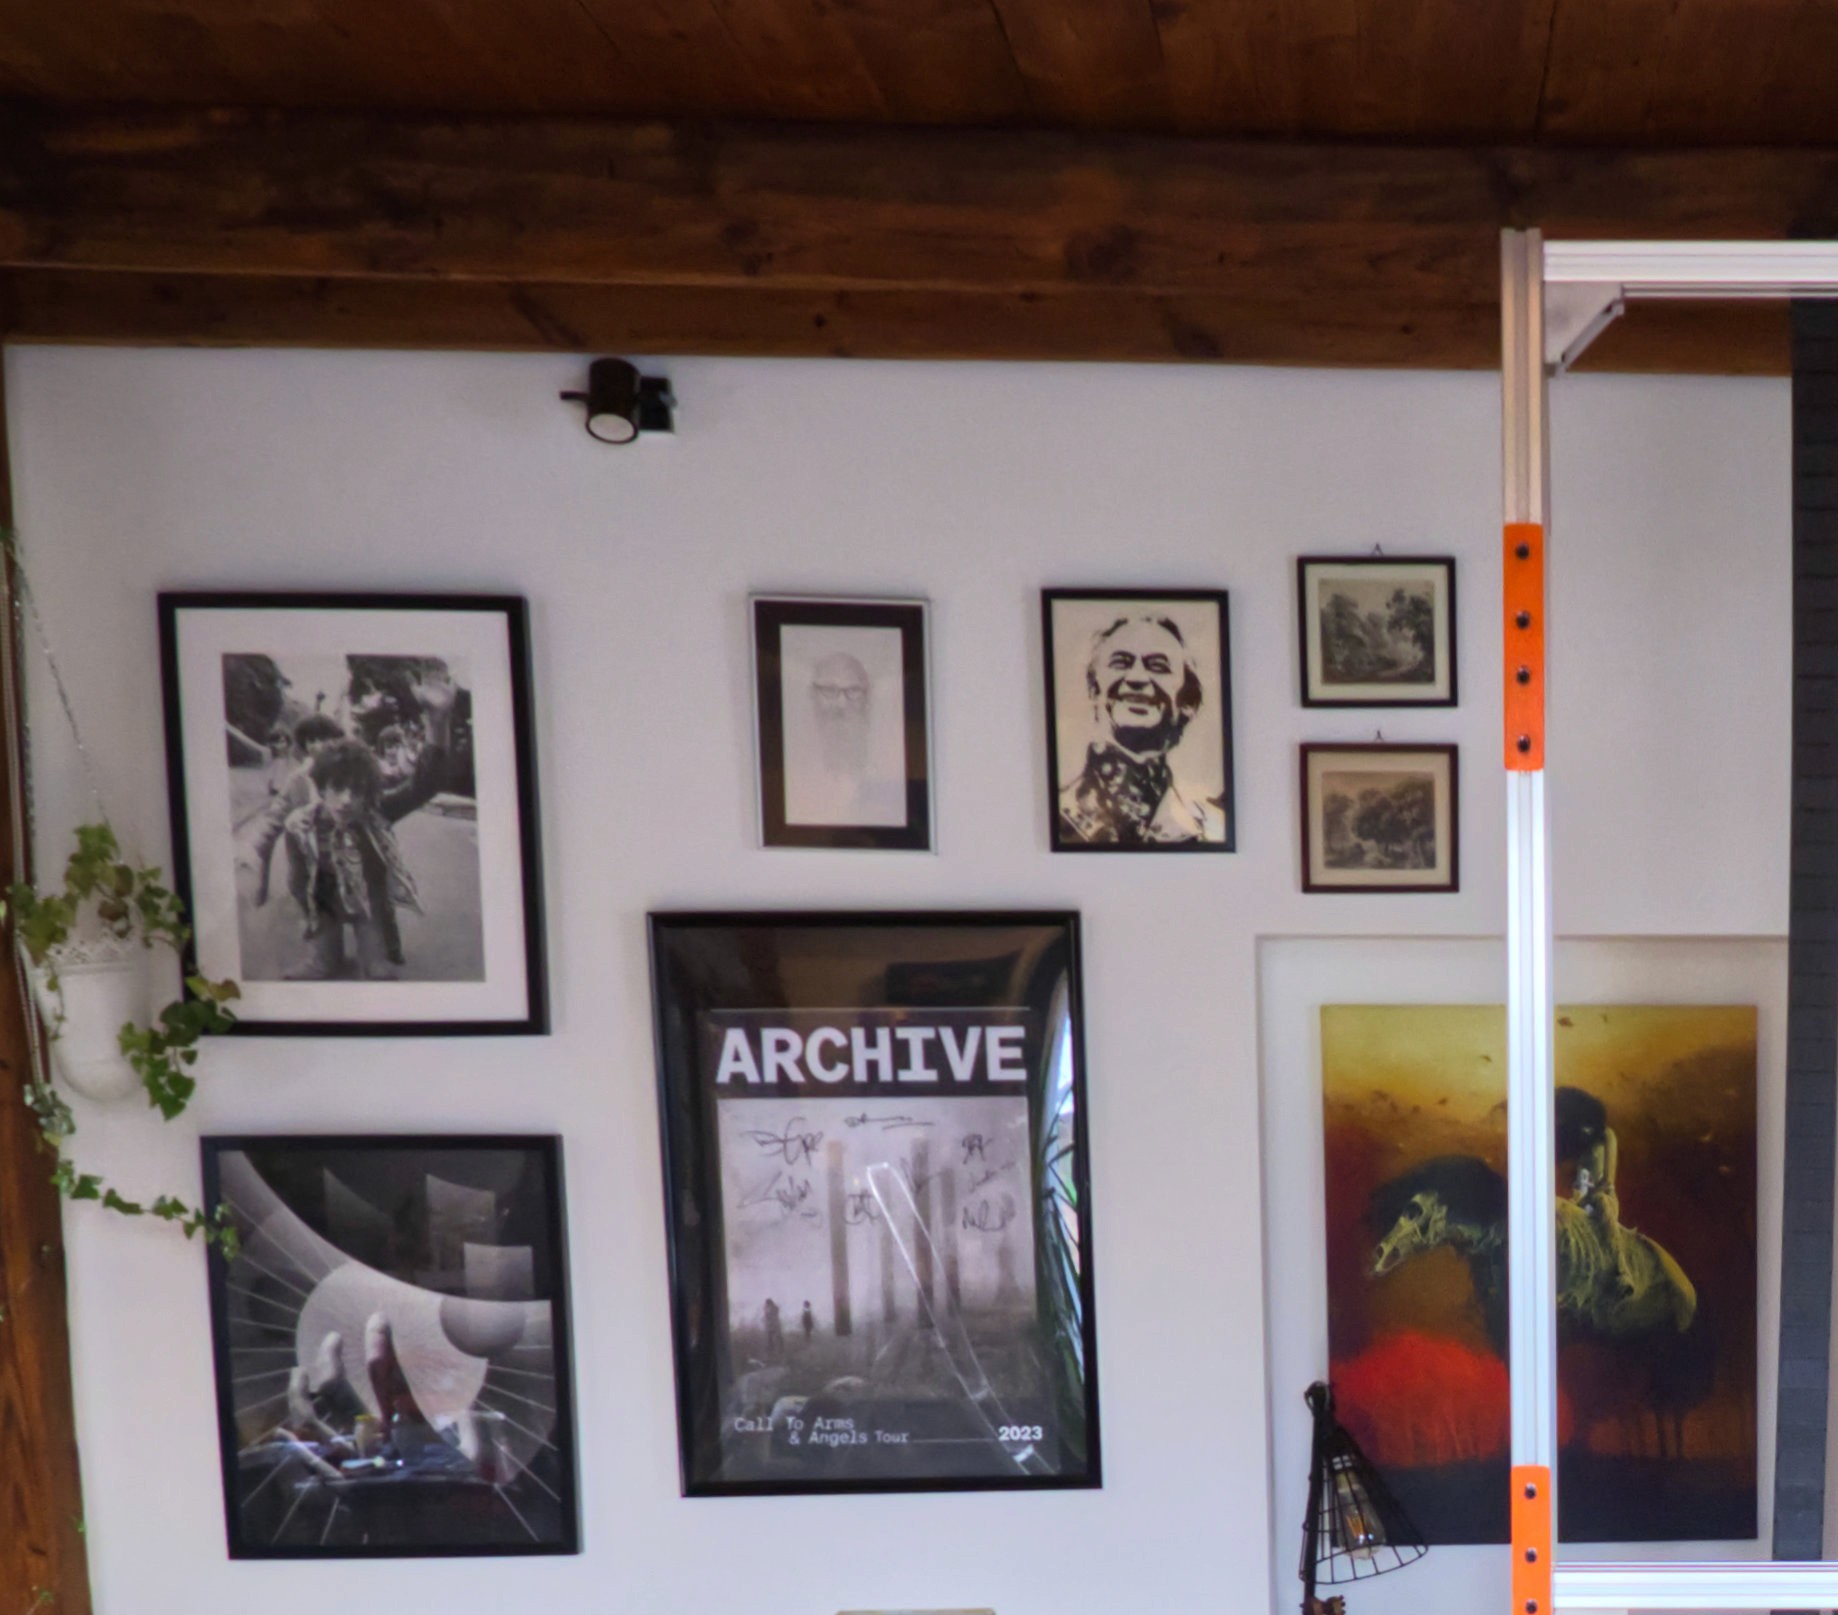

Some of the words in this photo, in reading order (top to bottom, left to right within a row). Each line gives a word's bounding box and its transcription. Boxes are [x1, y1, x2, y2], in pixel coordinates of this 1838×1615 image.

[716, 1026, 1027, 1083] ARCHIVE
[733, 1416, 775, 1432] Call
[786, 1416, 805, 1431] To
[814, 1416, 854, 1431] Arms
[788, 1431, 801, 1445] &
[808, 1430, 868, 1448] Angels
[874, 1430, 910, 1443] Tour
[997, 1425, 1043, 1441] 2023
